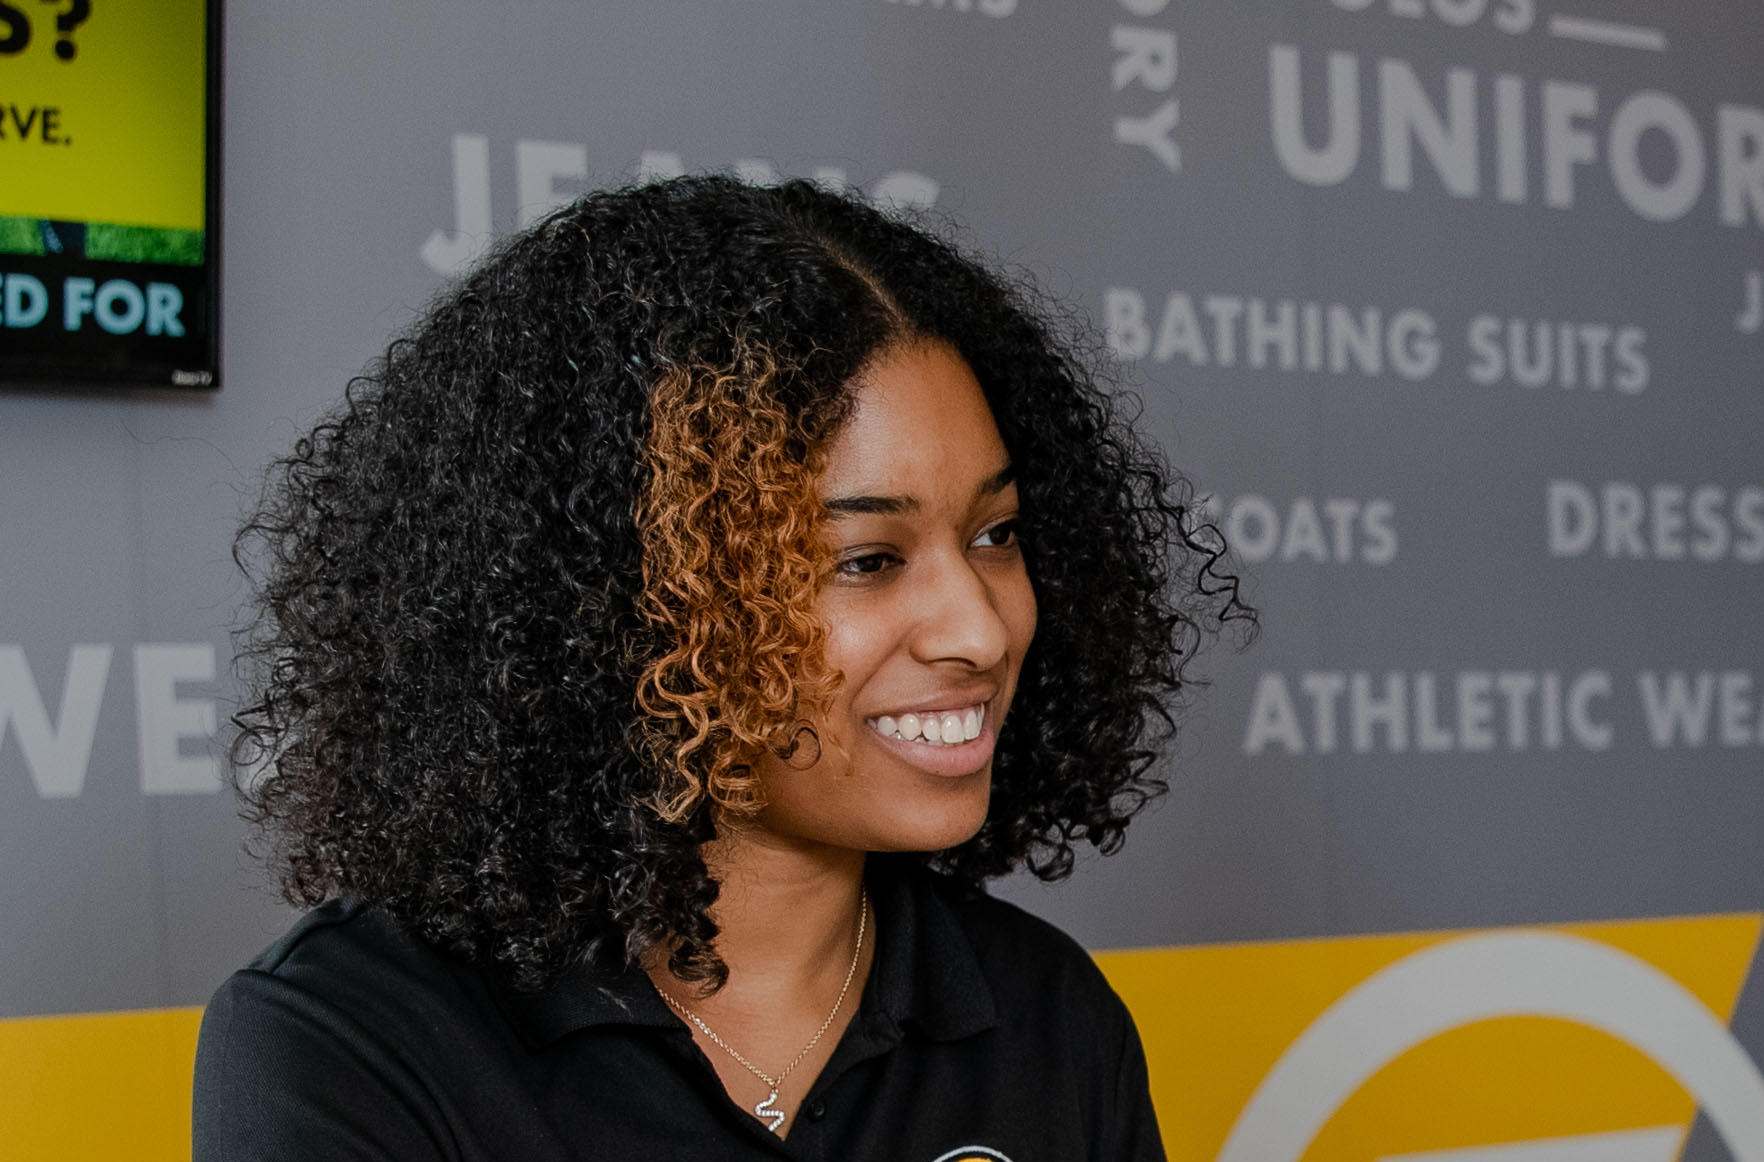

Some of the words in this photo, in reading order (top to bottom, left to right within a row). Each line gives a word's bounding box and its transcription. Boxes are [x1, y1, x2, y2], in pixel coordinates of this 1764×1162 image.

[0, 105, 72, 147] VE.
[1111, 0, 1183, 174] RY
[0, 272, 49, 329] D
[63, 276, 185, 338] FOR
[1104, 286, 1441, 381] BATHING
[1468, 315, 1651, 395] SUITS
[1243, 670, 1613, 758] ATHLETIC
